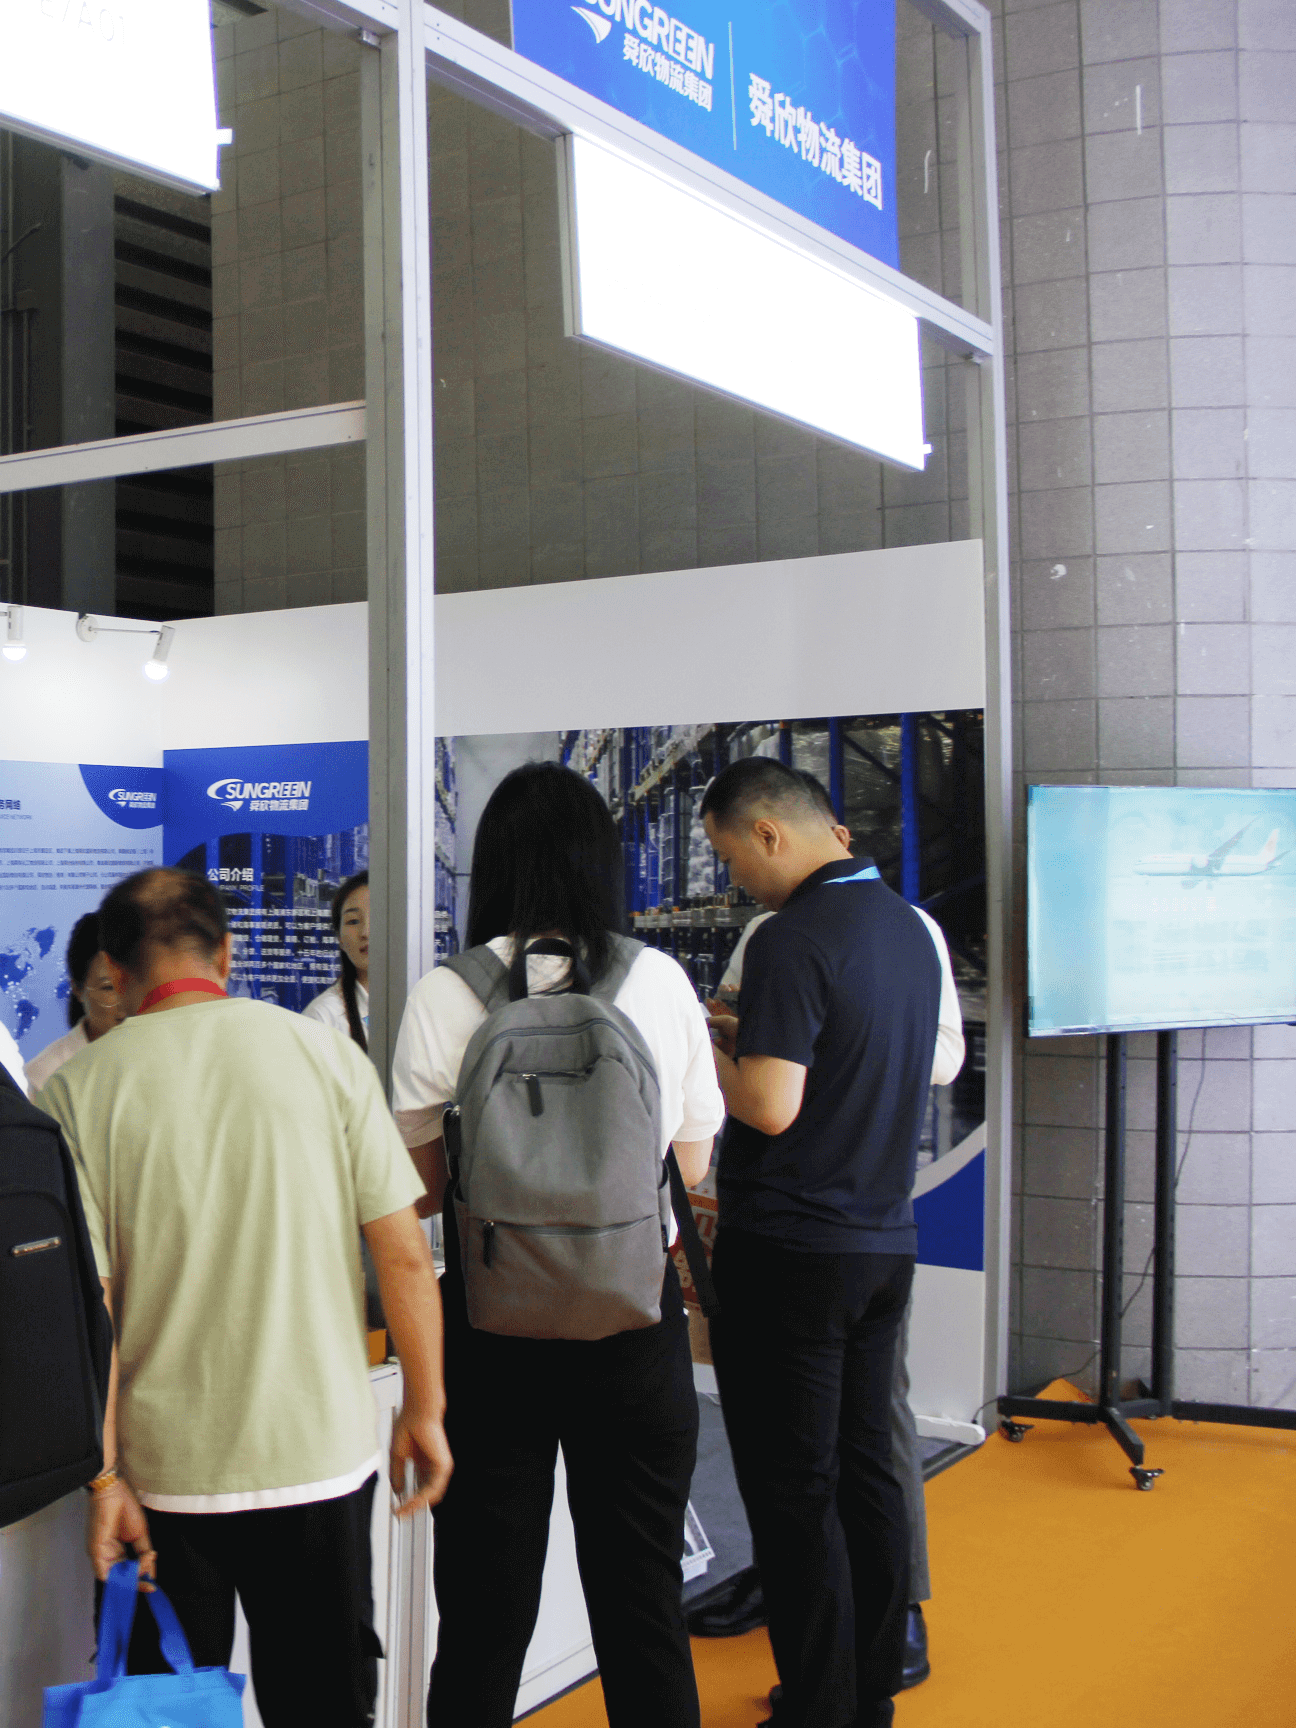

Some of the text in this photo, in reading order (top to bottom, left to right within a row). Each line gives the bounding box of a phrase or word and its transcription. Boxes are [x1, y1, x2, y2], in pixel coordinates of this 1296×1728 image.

[586, 0, 715, 79] UNGREEN
[623, 33, 713, 112] 舜欣物流集团
[749, 72, 884, 211] 舜欣物流集团
[224, 781, 313, 799] SUNGREEN
[207, 867, 254, 882] 公司介绍
